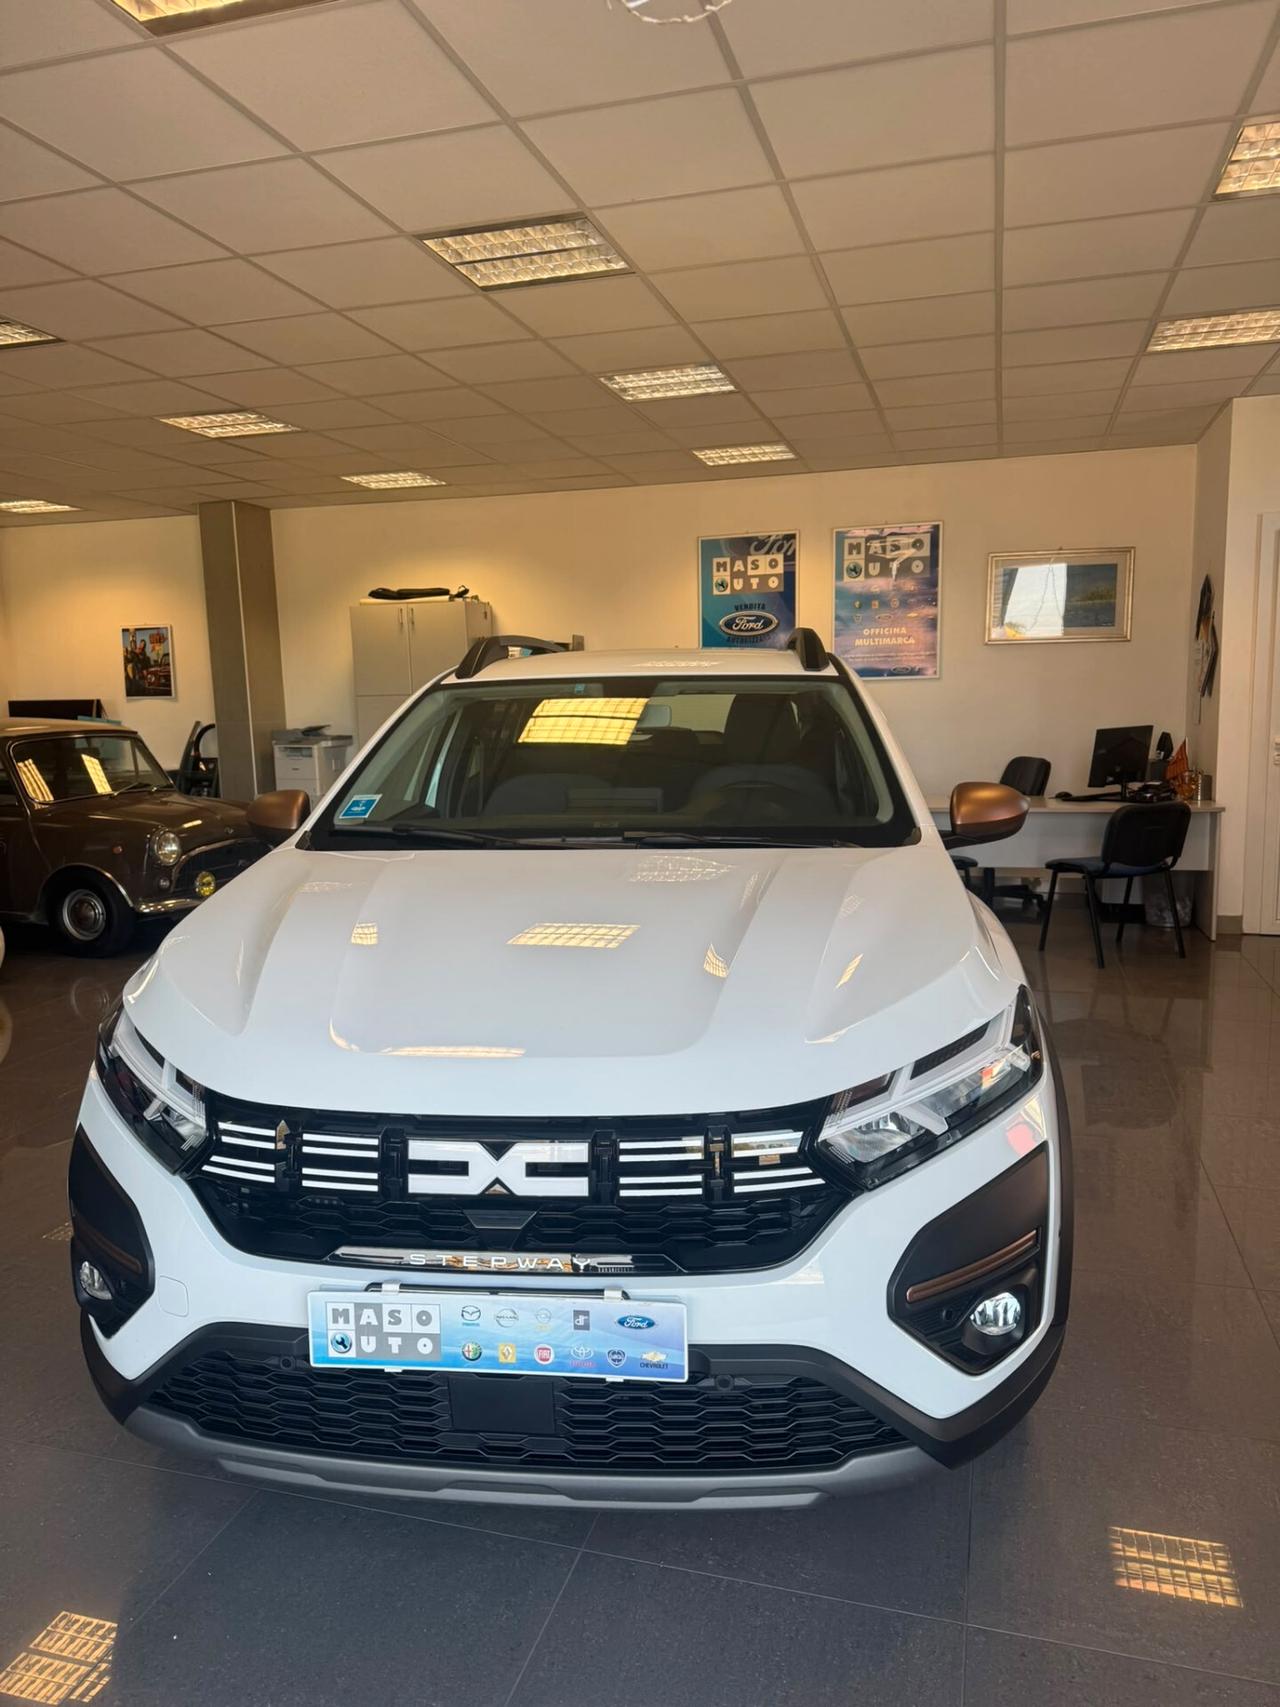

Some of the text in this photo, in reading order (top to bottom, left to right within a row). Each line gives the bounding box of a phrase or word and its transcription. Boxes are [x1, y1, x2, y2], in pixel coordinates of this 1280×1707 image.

[716, 558, 779, 573] MASO
[732, 616, 764, 631] Ford
[863, 627, 907, 636] OFFICINA
[855, 636, 915, 647] MULTIMARCA
[409, 1253, 590, 1273] STEPWAY
[332, 1308, 432, 1326] MASO
[623, 1317, 649, 1328] Ford
